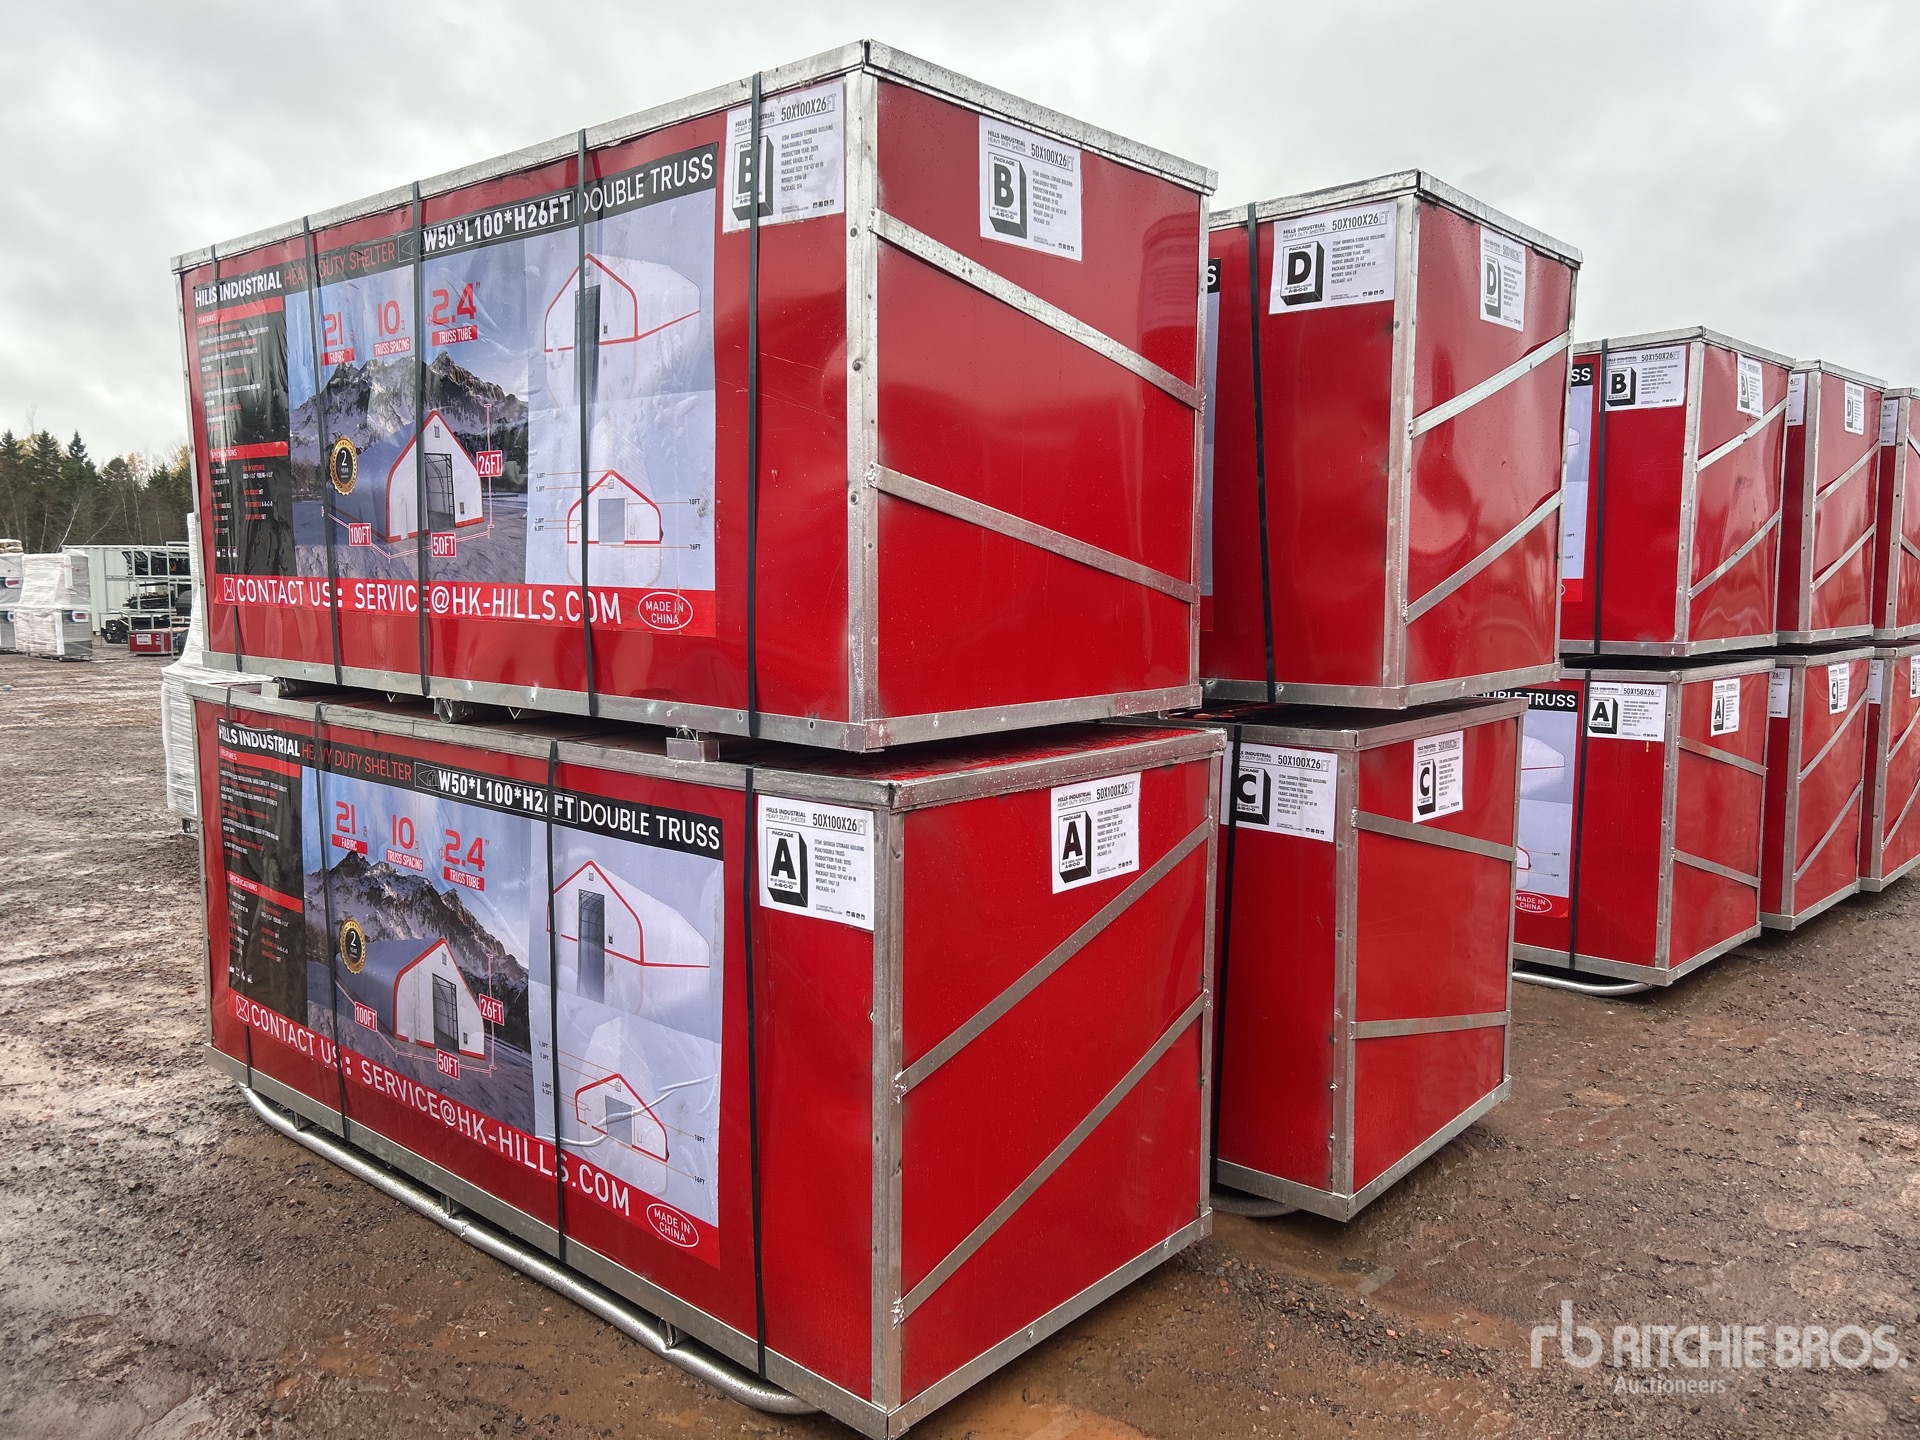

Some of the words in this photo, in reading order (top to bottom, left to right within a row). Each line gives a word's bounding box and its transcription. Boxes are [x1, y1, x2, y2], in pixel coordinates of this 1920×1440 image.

[988, 130, 1000, 138] HILLS
[994, 156, 1014, 166] PACKAGE
[650, 153, 714, 194] TRUSS
[994, 162, 1014, 208] B
[219, 271, 282, 301] INDUSTRIAL
[320, 255, 346, 278] DUTY
[350, 242, 395, 271] SHELTER
[1288, 251, 1312, 285] D
[1487, 262, 1496, 296] D
[378, 300, 400, 337] 10
[324, 312, 343, 347] 21
[438, 329, 457, 344] TRUSS
[457, 326, 472, 341] TUBE
[374, 342, 390, 356] TRUSS
[390, 338, 410, 353] SPACING
[1611, 373, 1627, 394] B
[1741, 373, 1748, 396] B
[341, 450, 347, 466] 2
[479, 454, 500, 474] 26FT
[350, 526, 370, 544] 100FT
[434, 537, 455, 554] 50FT
[237, 578, 304, 606] CONTACT
[645, 600, 674, 614] MADE
[676, 602, 684, 614] IN
[651, 613, 680, 626] CHINA
[1526, 692, 1576, 708] TRUSS
[1714, 700, 1721, 719] A
[1592, 702, 1610, 722] A
[239, 730, 300, 757] INDUSTRIAL
[334, 750, 362, 770] DUTY
[364, 754, 412, 782] SHELTER
[1237, 774, 1257, 804] C
[1420, 767, 1430, 796] C
[336, 801, 356, 834] 21
[779, 809, 806, 818] INDUSTRIAL
[392, 814, 414, 850] 10
[580, 800, 650, 837] DOUBLE
[656, 815, 720, 850] TRUSS
[772, 830, 794, 838] PACKAGE
[1062, 821, 1083, 860] A
[387, 850, 402, 865] TRUSS
[402, 855, 423, 870] SPACING
[771, 838, 796, 880] A
[450, 869, 466, 884] TRUSS
[466, 873, 480, 890] TUBE
[1516, 896, 1536, 904] MADE
[1520, 902, 1541, 910] CHINA
[351, 931, 357, 947] 2
[355, 1005, 377, 1029] 100FT
[481, 998, 503, 1024] 26FT
[438, 1053, 459, 1077] 50FT
[251, 1004, 315, 1056] CONTACT
[321, 1040, 352, 1076] US:
[361, 1059, 630, 1217] SERVICE@HK-HILLS.COM
[694, 1134, 705, 1143] 18FT
[694, 1176, 705, 1185] 16FT
[654, 1208, 678, 1229] MADE
[681, 1220, 690, 1235] IN
[659, 1222, 686, 1243] CHINA
